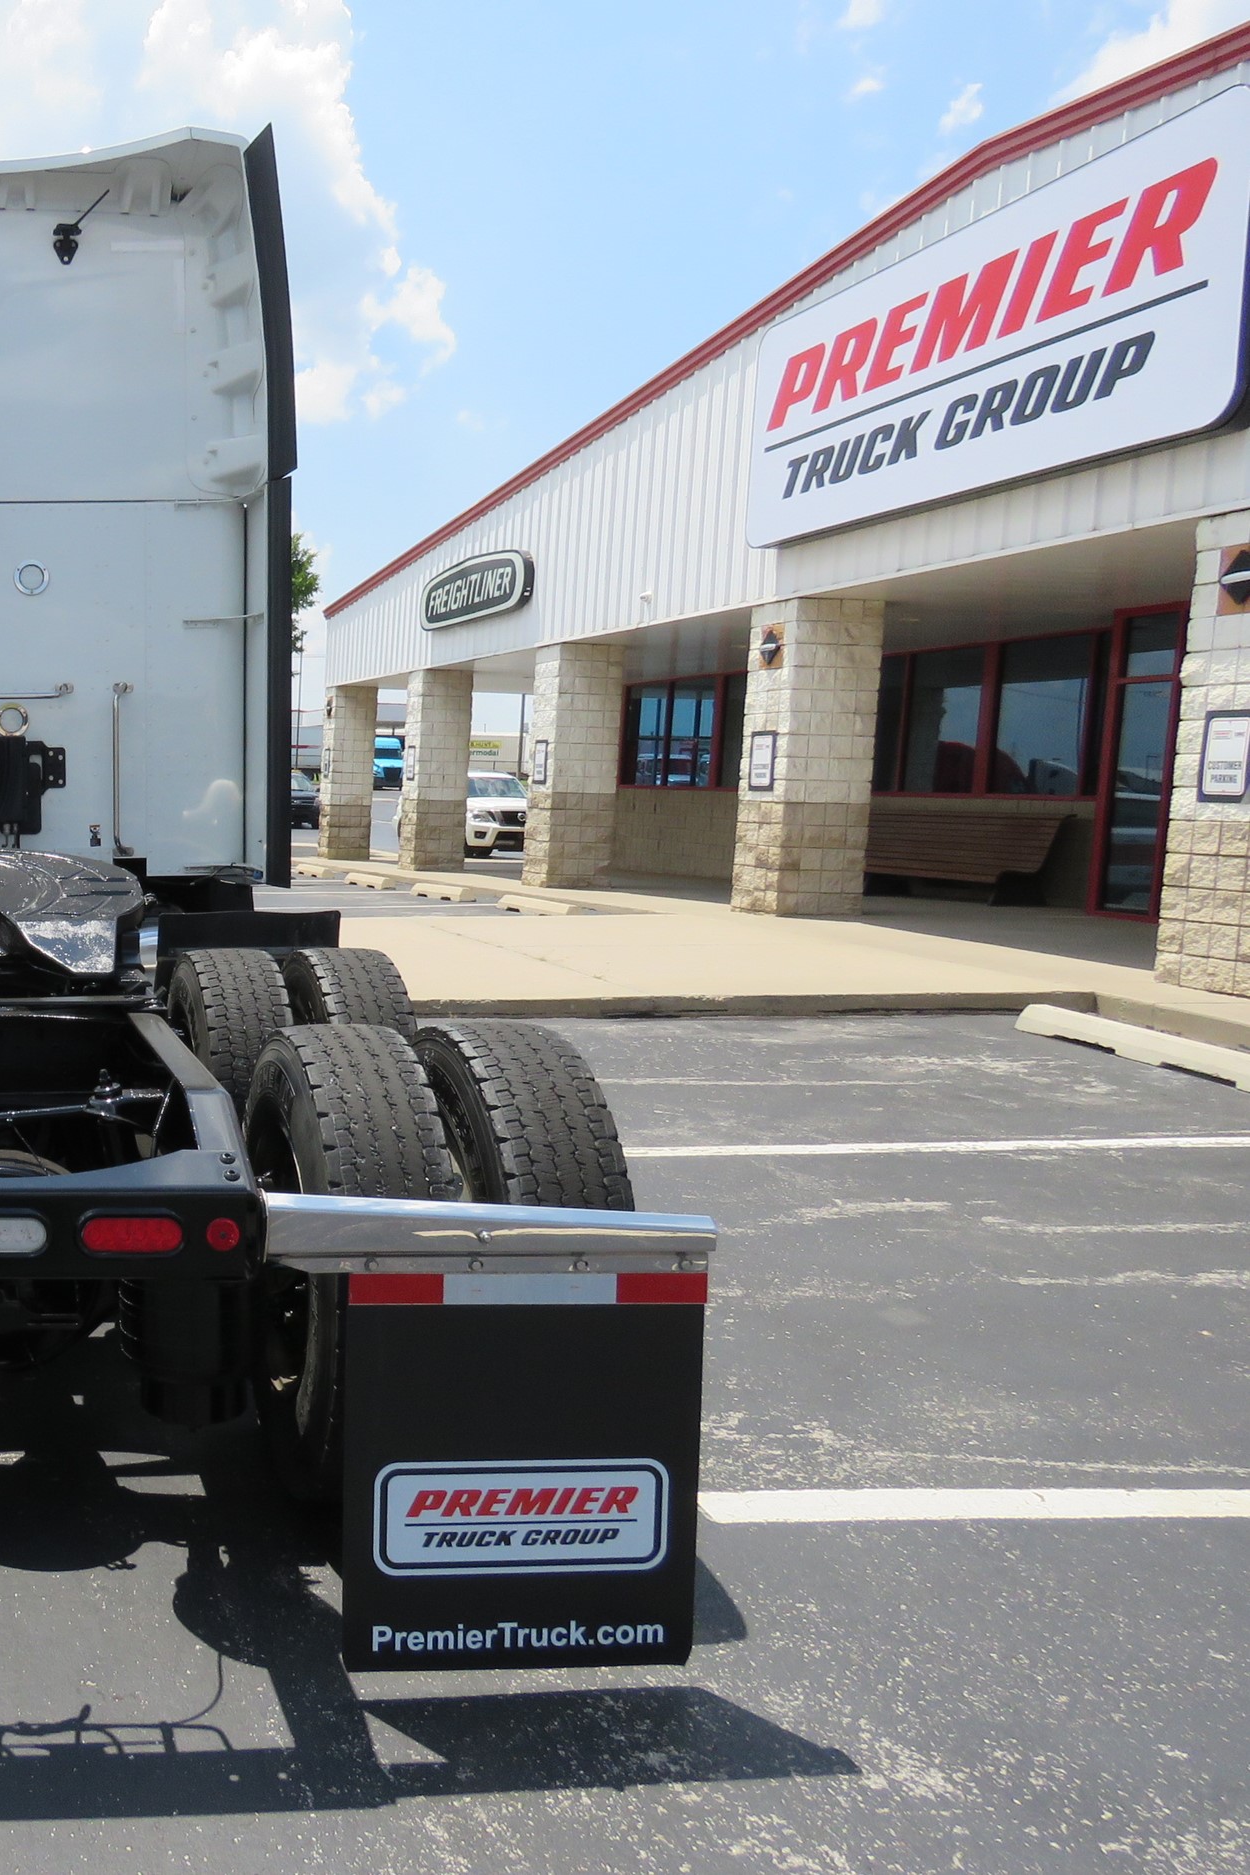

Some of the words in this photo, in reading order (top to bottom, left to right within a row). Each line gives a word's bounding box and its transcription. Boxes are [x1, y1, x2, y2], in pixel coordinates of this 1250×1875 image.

[765, 156, 1218, 432] PREMIER
[782, 408, 933, 500] TRUCK
[934, 330, 1156, 450] GROUP
[427, 566, 512, 617] FREIGHTLINER
[405, 1485, 641, 1518] PREMIER
[422, 1530, 517, 1548] TRUCK
[521, 1527, 620, 1546] GROUP
[371, 1620, 665, 1653] PremierTruck.com
